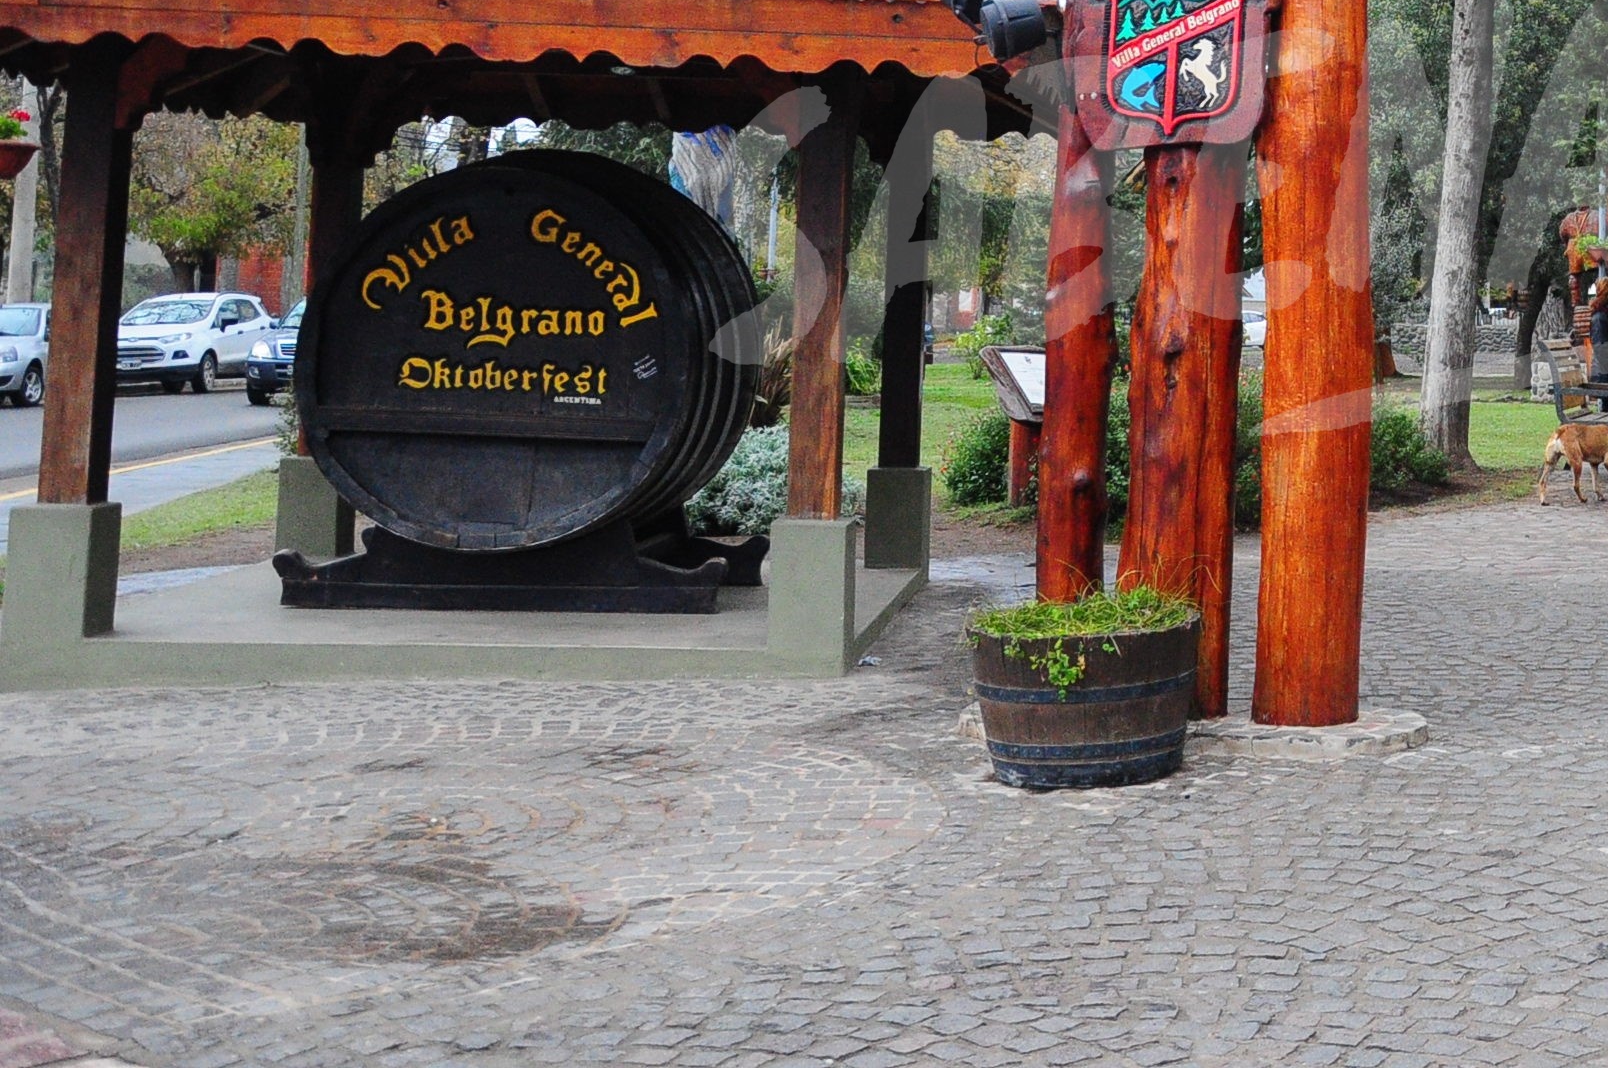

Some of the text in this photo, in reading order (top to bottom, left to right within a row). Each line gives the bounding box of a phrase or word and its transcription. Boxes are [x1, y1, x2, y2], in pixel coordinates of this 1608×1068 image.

[1111, 43, 1140, 68] Villa
[1142, 20, 1186, 52] General
[361, 209, 658, 328] Villa General
[420, 288, 605, 349] Belgrano
[398, 356, 607, 395] Oktoberfest
